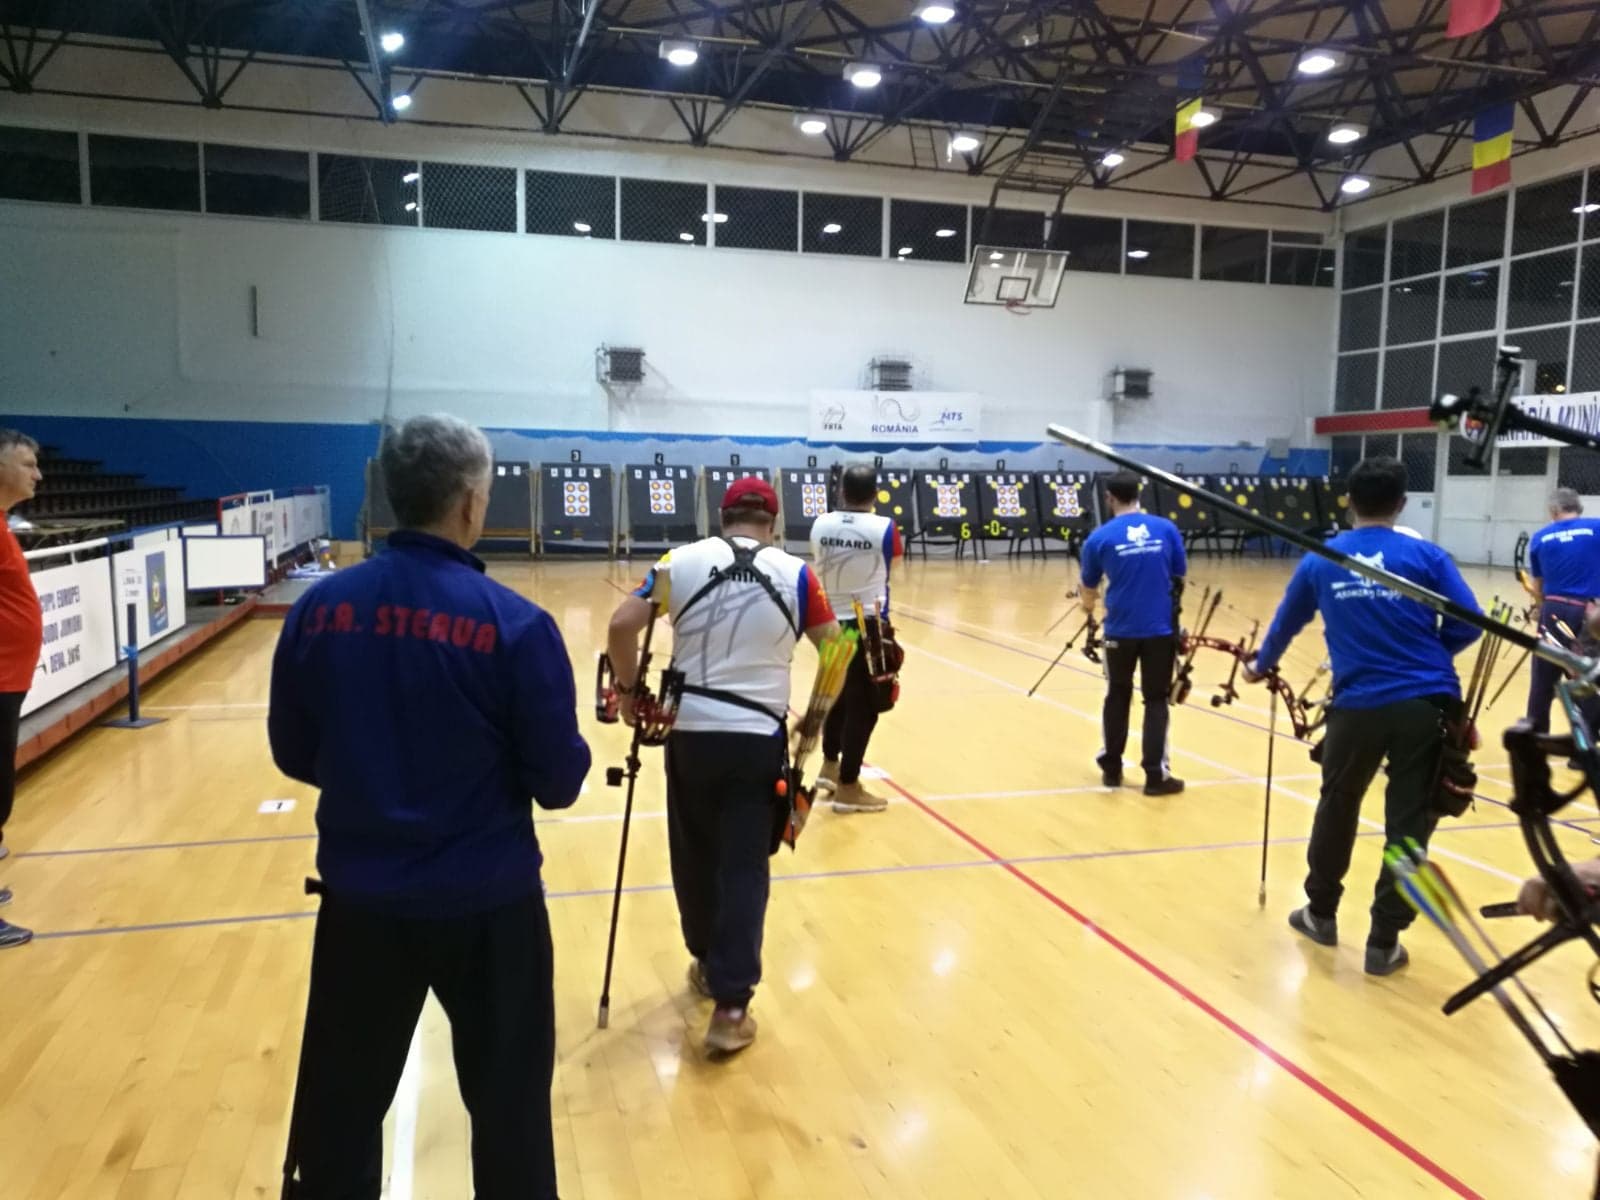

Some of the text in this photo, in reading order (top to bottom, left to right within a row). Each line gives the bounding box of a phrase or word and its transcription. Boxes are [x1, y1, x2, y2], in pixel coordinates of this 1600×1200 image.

[871, 423, 919, 434] ROMÂNIA
[820, 537, 873, 550] GERARD
[375, 604, 497, 654] STEAUA
